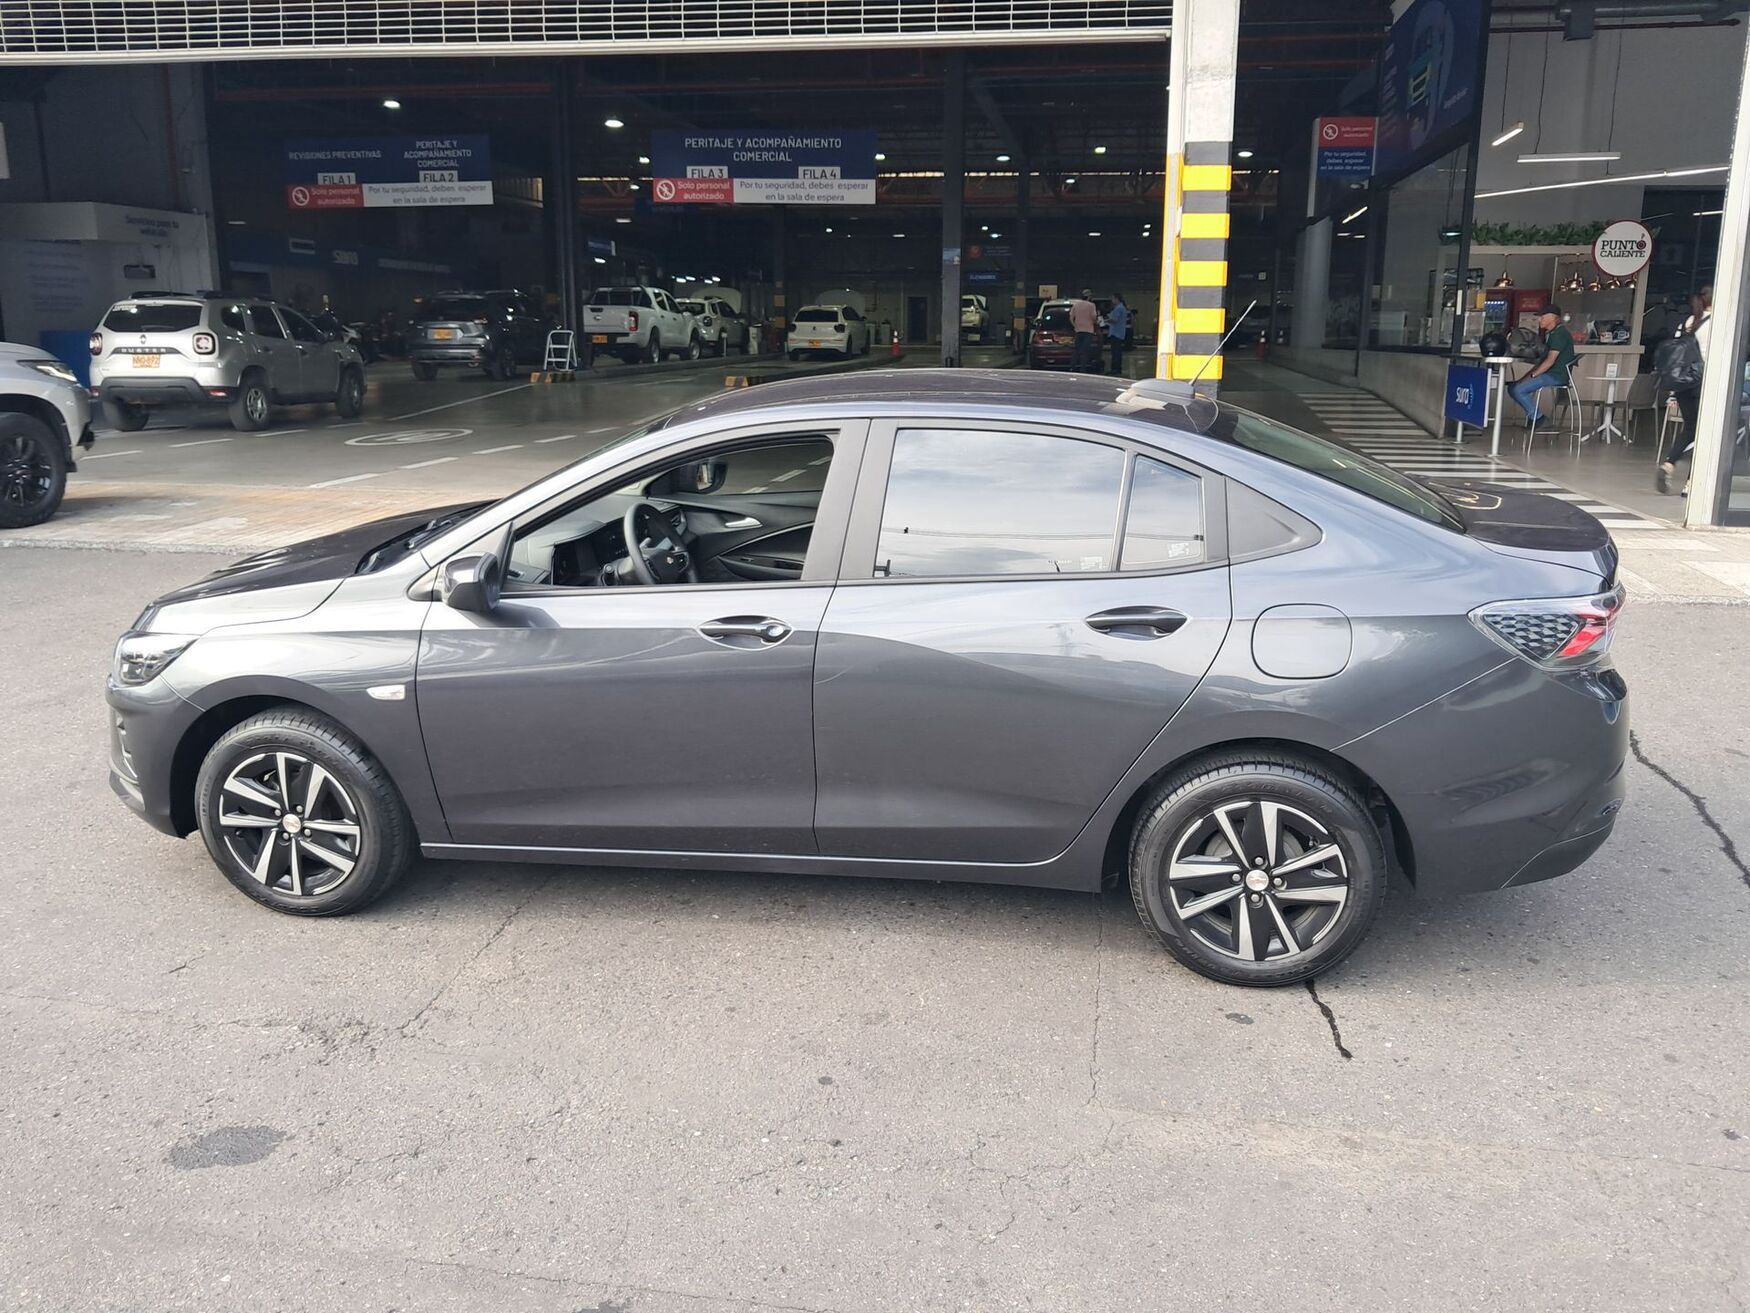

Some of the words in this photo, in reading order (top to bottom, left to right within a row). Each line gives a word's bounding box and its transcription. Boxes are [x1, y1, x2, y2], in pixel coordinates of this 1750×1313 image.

[415, 140, 452, 149] PERITAJE
[453, 140, 458, 148] Y
[685, 138, 734, 149] PERITAJE
[736, 138, 744, 149] Y
[745, 136, 842, 149] ACOMPAÑAMIENTO
[288, 151, 331, 160] REVISIONES
[332, 150, 382, 159] PREVENTIVAS
[404, 148, 472, 159] ACOMPAÑAMIENTO
[733, 151, 792, 162] COMERCIAL
[417, 160, 459, 168] COMERCIAL
[423, 173, 446, 183] FILA
[448, 173, 454, 182] 2
[691, 169, 716, 179] FILA
[717, 169, 724, 178] 3
[803, 169, 828, 179] FILA
[829, 169, 837, 179] 4
[323, 176, 344, 184] FILA
[347, 175, 351, 184] 1
[457, 185, 486, 194] esperar
[677, 181, 695, 190] Solo
[696, 181, 730, 191] personal
[740, 181, 752, 189] Por
[808, 181, 833, 190] debes
[837, 182, 869, 192] esperar
[311, 187, 328, 195] Solo
[329, 187, 360, 196] personal
[683, 191, 725, 200] autorizado
[393, 197, 403, 205] en
[440, 196, 466, 204] espera
[765, 193, 776, 201] en
[777, 192, 785, 200] la
[786, 192, 802, 200] sala
[804, 192, 815, 200] de
[816, 194, 845, 203] espera
[1601, 239, 1647, 251] PUNTO
[1600, 250, 1646, 258] CALIENTE
